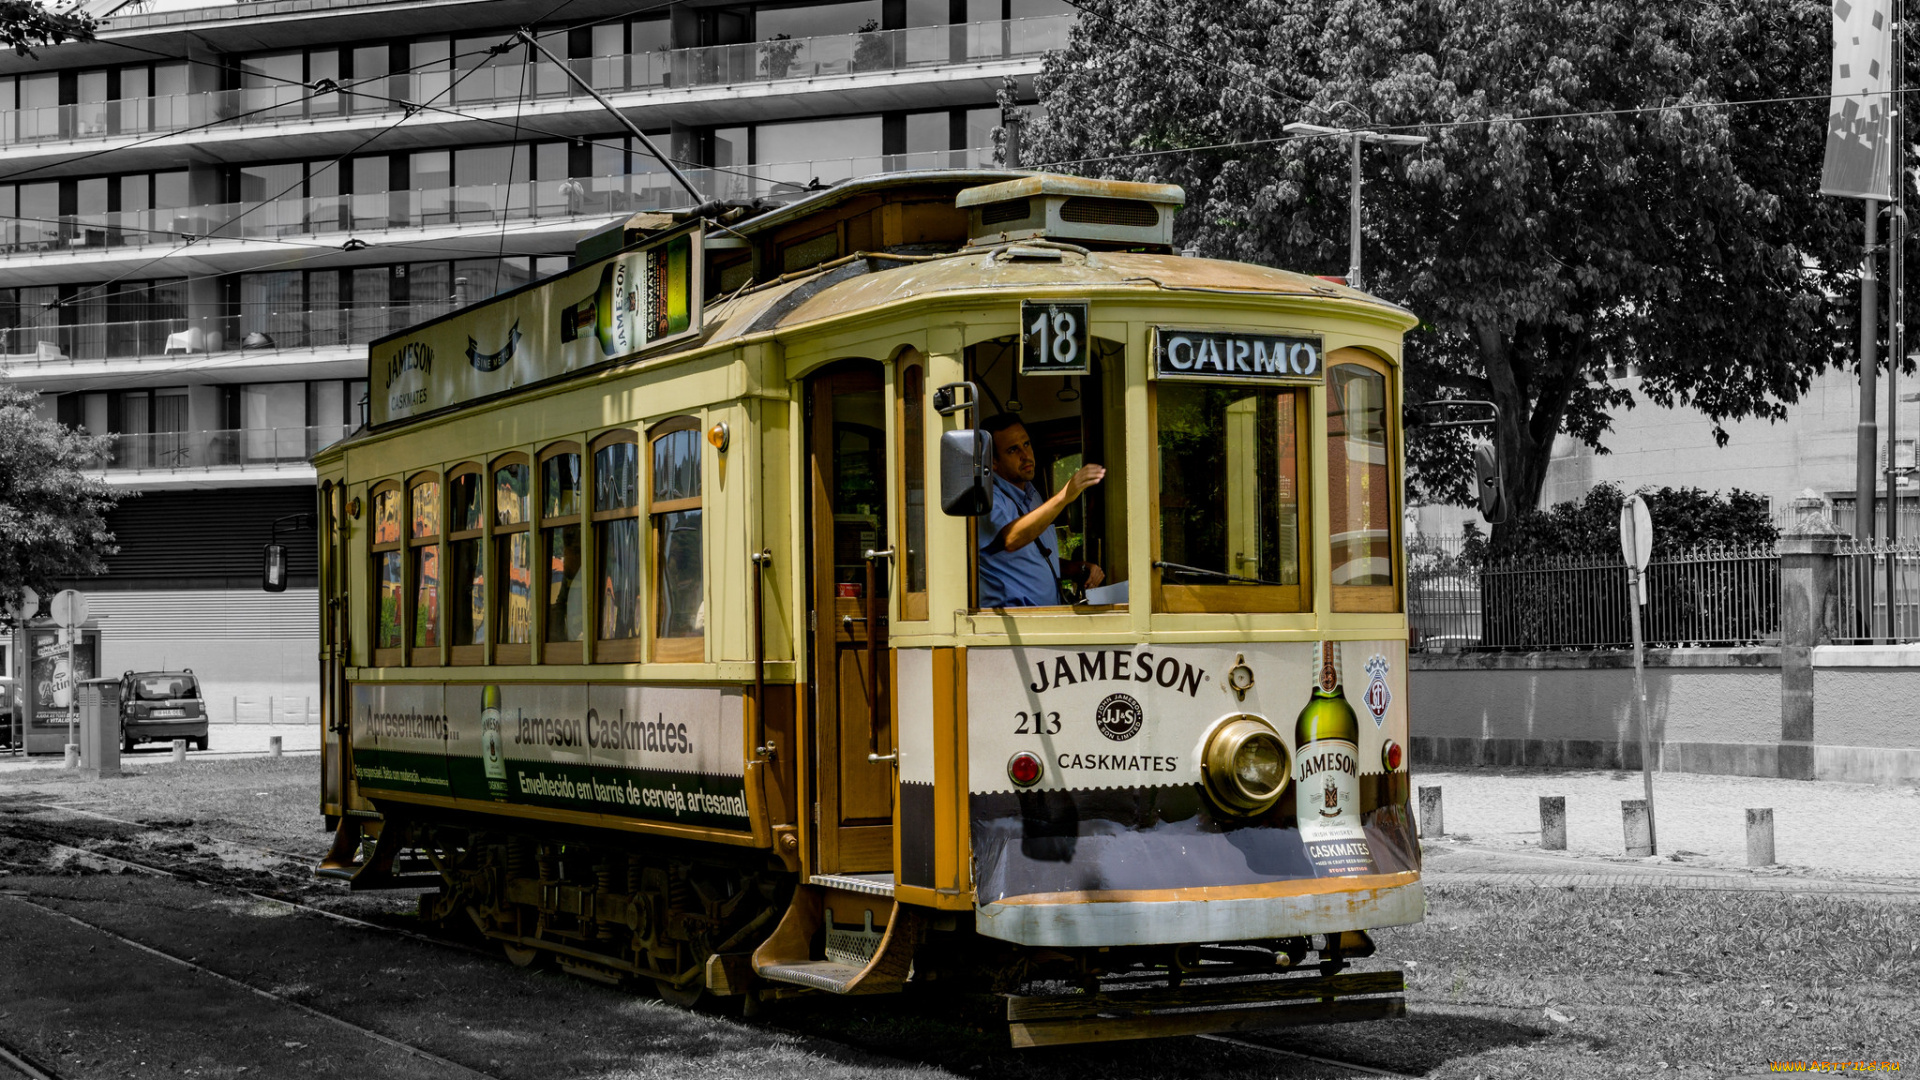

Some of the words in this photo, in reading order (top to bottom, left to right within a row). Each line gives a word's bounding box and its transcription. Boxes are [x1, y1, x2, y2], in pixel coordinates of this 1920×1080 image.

[615, 264, 627, 346] JAMESON
[1030, 312, 1078, 364] 18
[386, 342, 433, 389] JAMESON
[476, 357, 491, 369] SINE
[492, 348, 510, 367] METU
[1167, 336, 1317, 375] CARMO
[391, 388, 428, 412] CASKMATES
[1030, 650, 1205, 698] JAMESON
[1097, 696, 1112, 714] JOHN
[1114, 694, 1142, 715] JAMESON
[1102, 708, 1134, 724] JJ&S
[366, 704, 460, 745] Apresentamos...
[515, 707, 582, 747] Jameson
[587, 708, 693, 754] Caskmates.
[1013, 711, 1062, 735] 213
[1100, 727, 1115, 739] SON
[1116, 721, 1141, 741] LIMITED
[1058, 753, 1177, 772] CASKMATES
[1300, 752, 1357, 782] JAMESON
[518, 770, 575, 799] Envelhecido
[576, 781, 594, 800] em
[592, 777, 625, 804] barris
[625, 780, 640, 805] de
[642, 783, 686, 817] cerveja
[687, 788, 750, 818] artesanal.
[1312, 830, 1328, 838] IRISH
[1329, 829, 1354, 837] WHISKEY
[1309, 843, 1370, 858] CASKMATES
